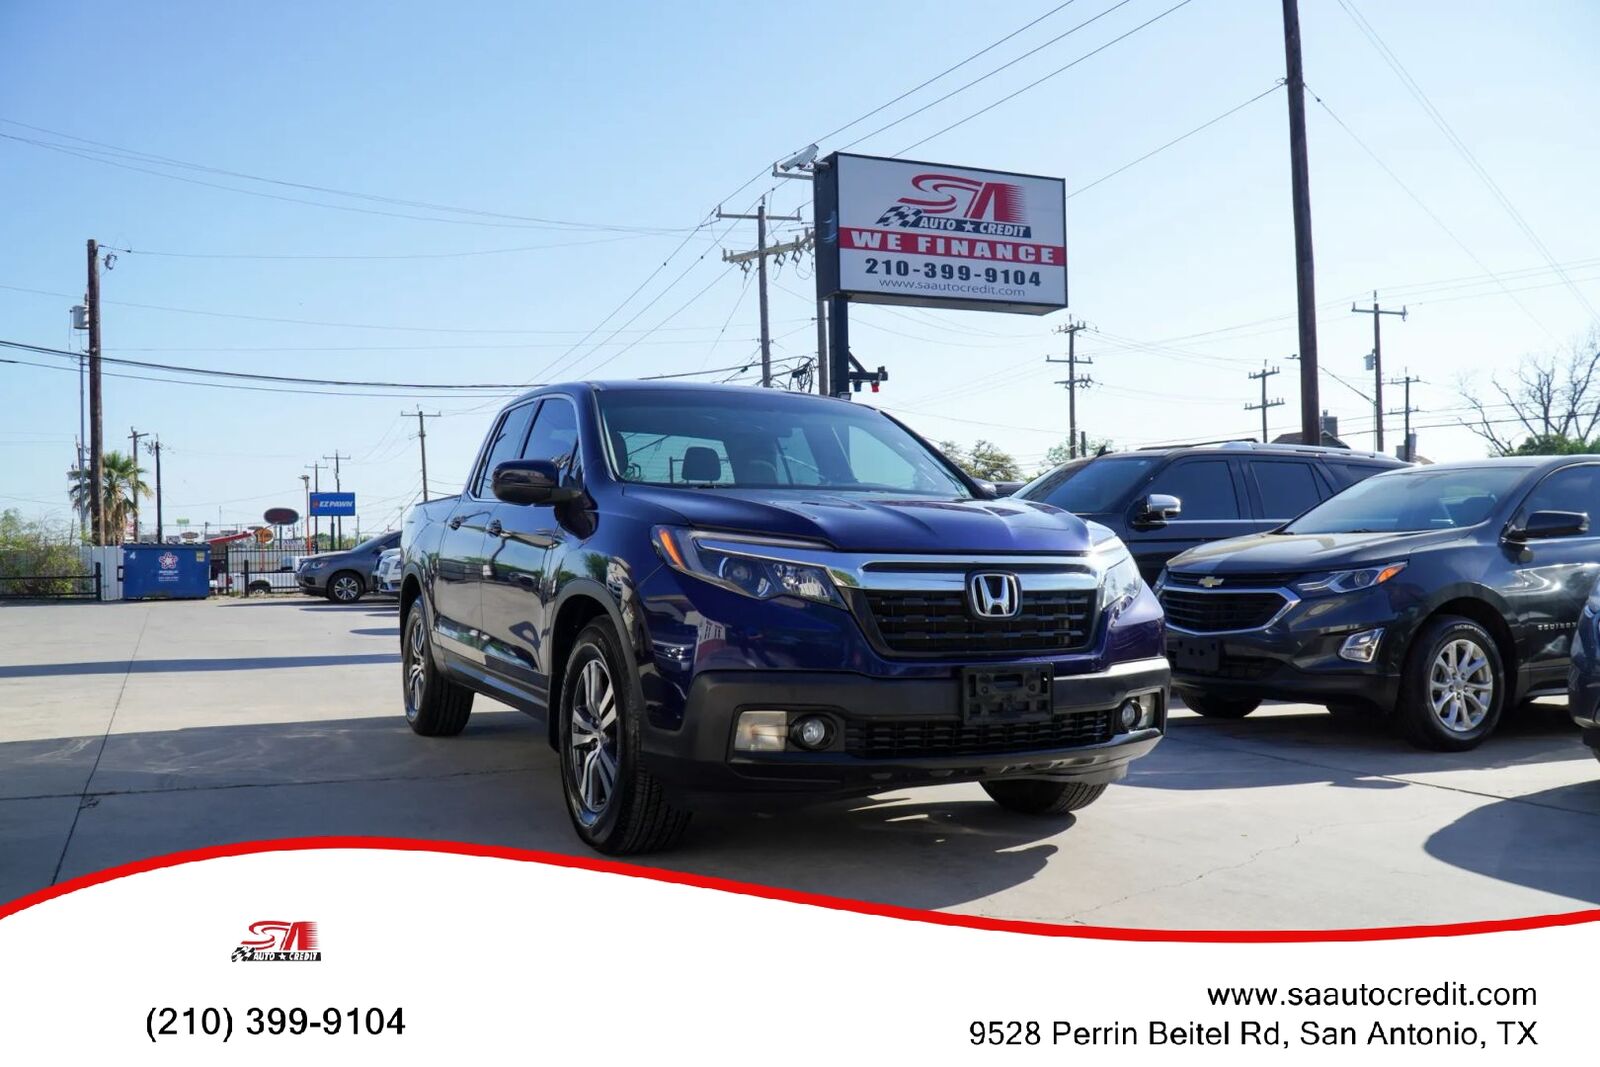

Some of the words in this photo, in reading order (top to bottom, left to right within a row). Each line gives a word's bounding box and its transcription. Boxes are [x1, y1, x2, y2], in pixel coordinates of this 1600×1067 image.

[919, 216, 956, 231] AUTO
[979, 222, 1027, 238] CREDIT
[851, 230, 902, 251] WE
[917, 236, 1054, 264] FINANCE
[865, 257, 1041, 287] 210-399-9104
[879, 277, 1025, 297] www.saautocredit.com
